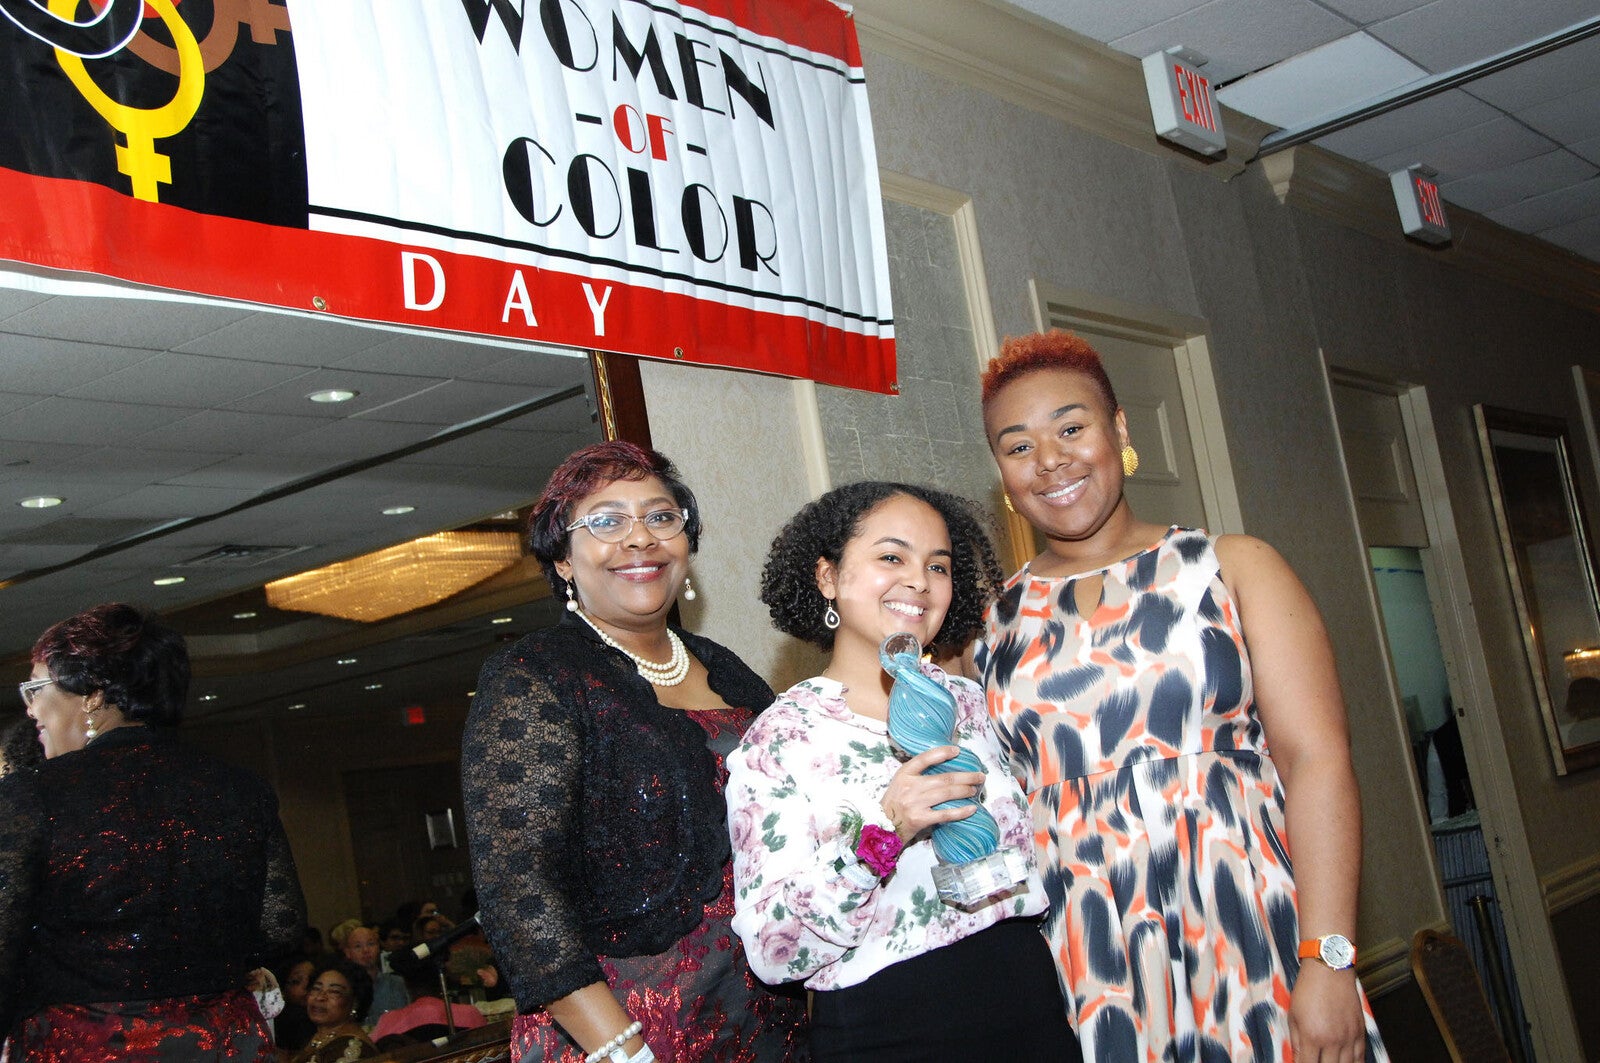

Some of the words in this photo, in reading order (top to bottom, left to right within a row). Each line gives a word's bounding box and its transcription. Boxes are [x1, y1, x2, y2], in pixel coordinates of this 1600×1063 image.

[461, 0, 775, 131] WOMEN
[1174, 64, 1216, 133] EXIT
[502, 136, 780, 277] COLOR
[1415, 177, 1445, 228] EXIT
[401, 251, 612, 337] DAY
